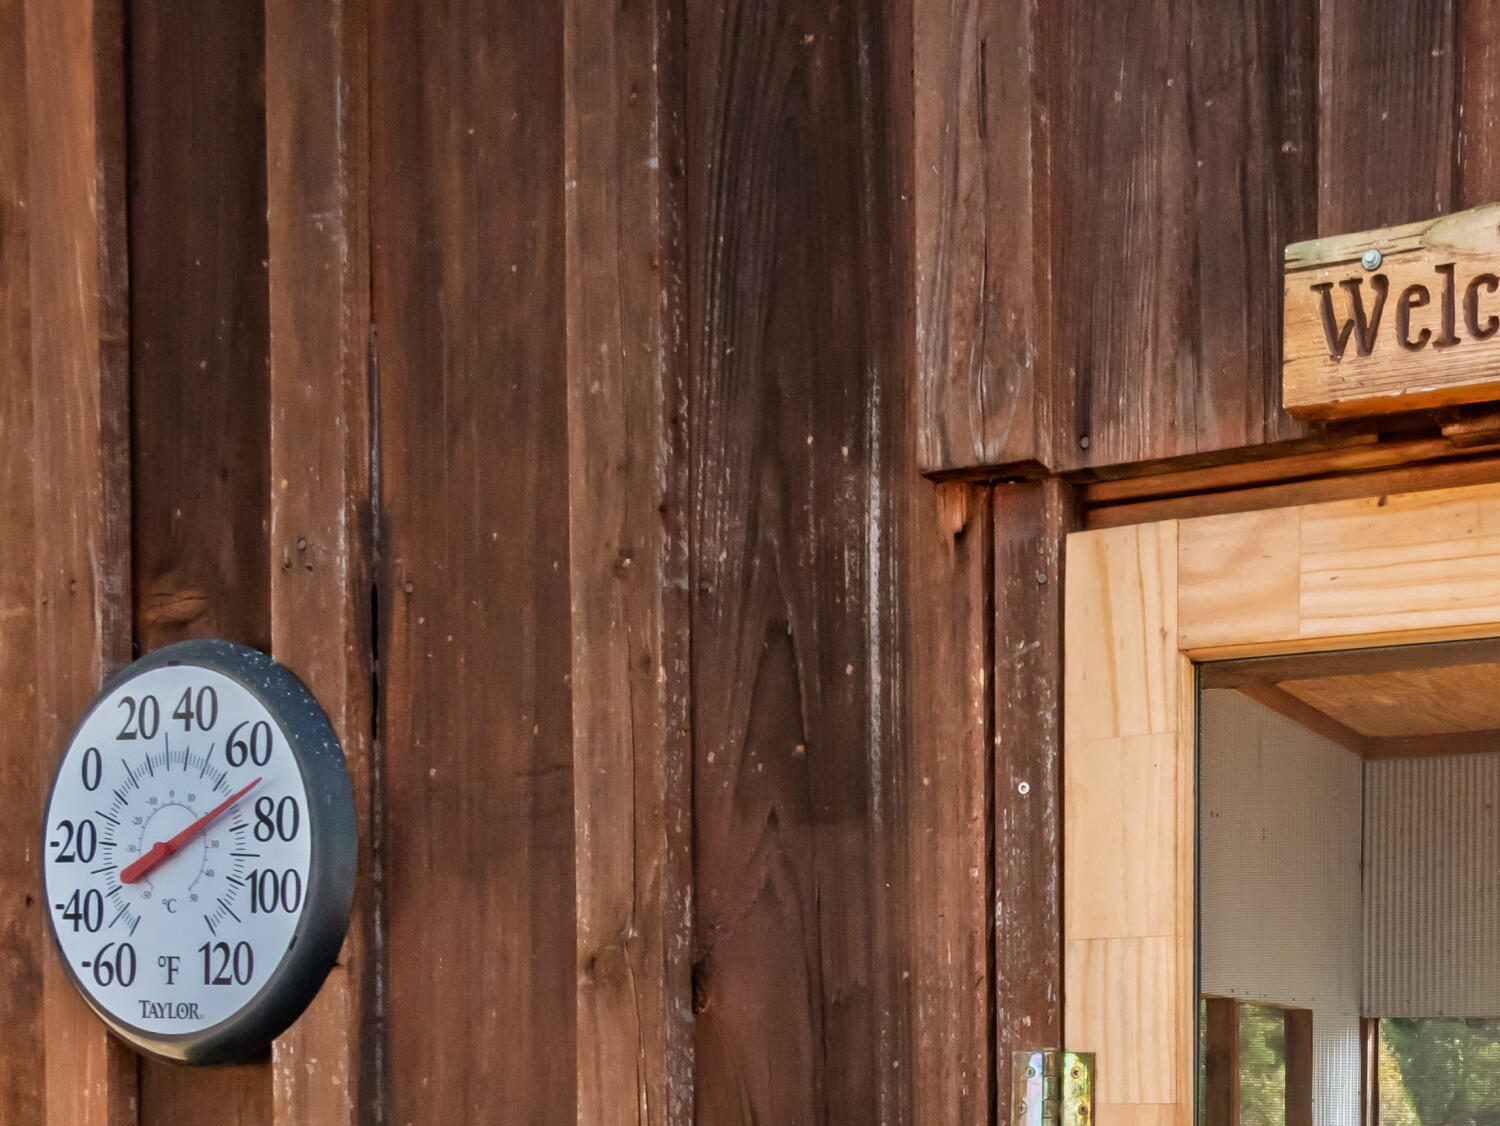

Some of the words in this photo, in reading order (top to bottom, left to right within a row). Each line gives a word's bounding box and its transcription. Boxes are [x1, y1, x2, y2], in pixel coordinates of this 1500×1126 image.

[115, 695, 160, 740] 20
[172, 685, 218, 731] 40
[226, 720, 273, 767] 60
[82, 747, 102, 791] 0
[50, 820, 97, 863] -20
[254, 796, 299, 842] 80
[55, 888, 104, 932] -40
[246, 868, 301, 914] 100
[82, 942, 137, 987] -60
[158, 955, 180, 985] °F
[199, 941, 254, 986] 120
[138, 1000, 200, 1019] TAYLOR
